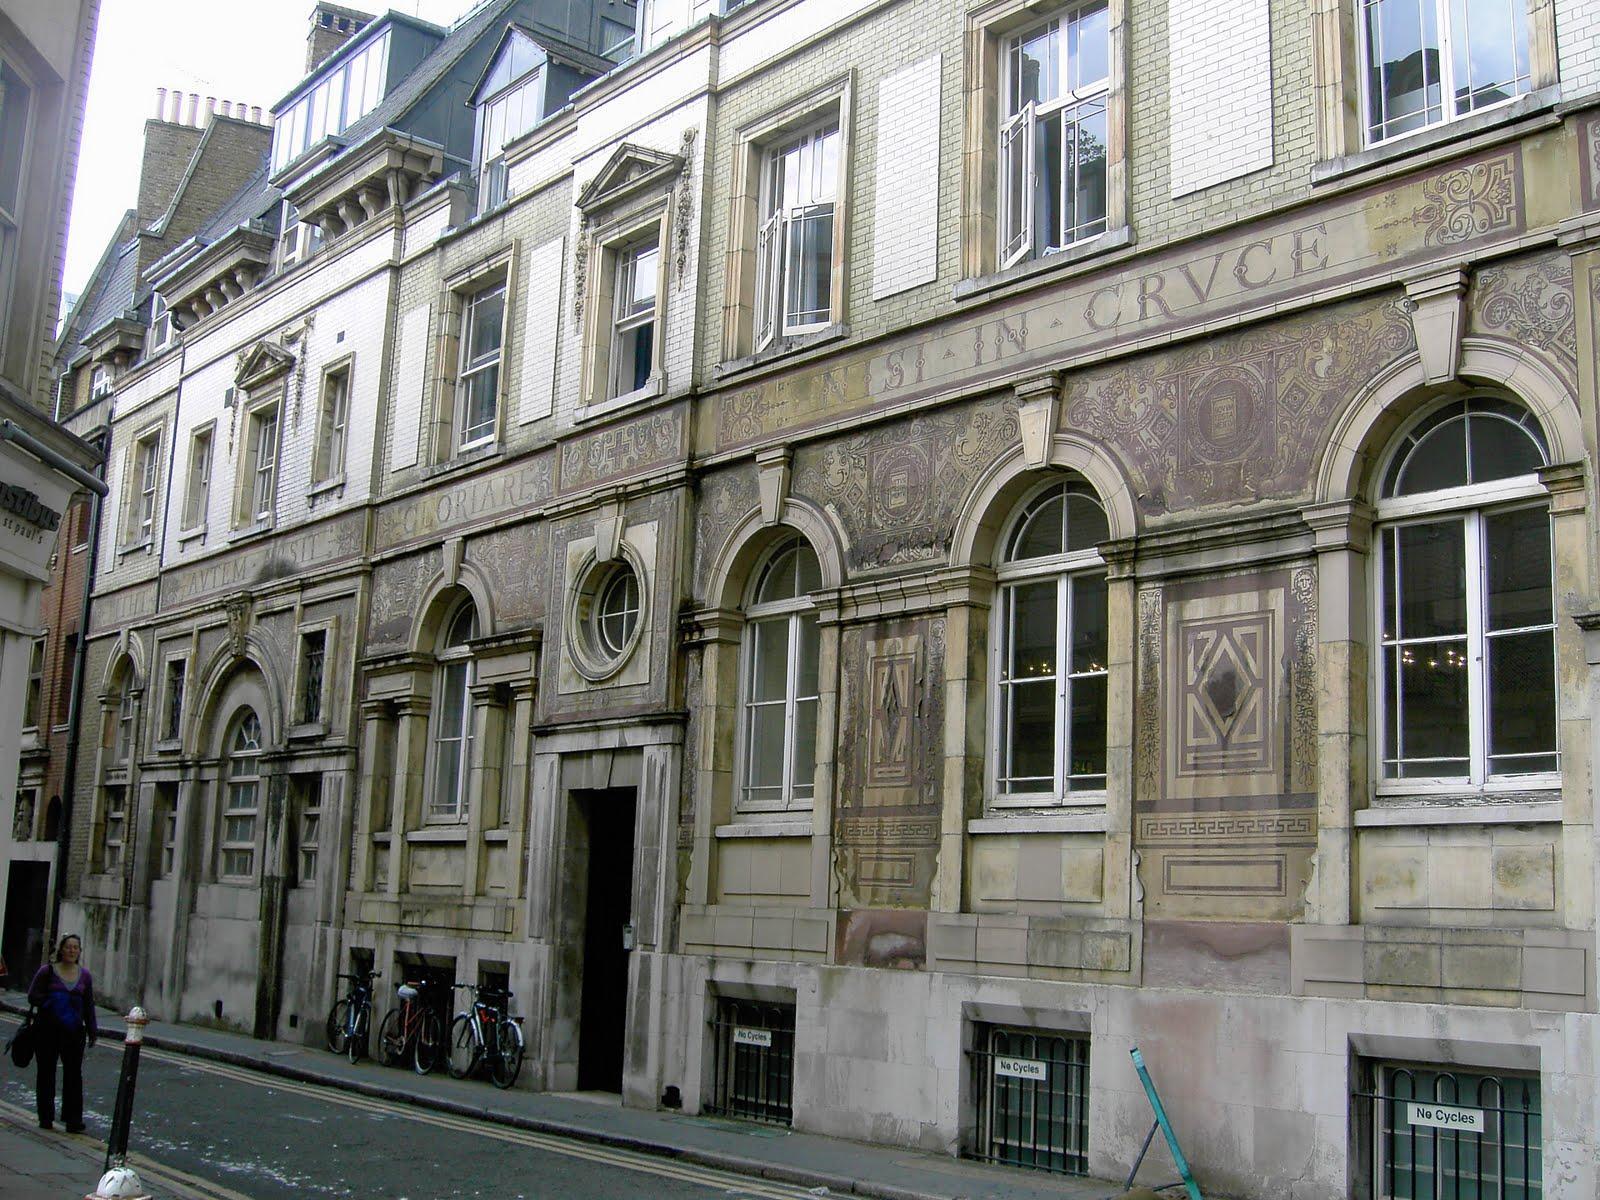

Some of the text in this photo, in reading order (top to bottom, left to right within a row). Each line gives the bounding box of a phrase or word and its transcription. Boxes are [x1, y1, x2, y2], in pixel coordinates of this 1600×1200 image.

[973, 308, 1030, 367] IN
[1083, 222, 1331, 332] CRVCE
[14, 522, 42, 545] paul's
[738, 1030, 768, 1042] No Cycles
[1000, 1060, 1040, 1075] No Cycles
[1416, 1107, 1475, 1124] No Cycles
